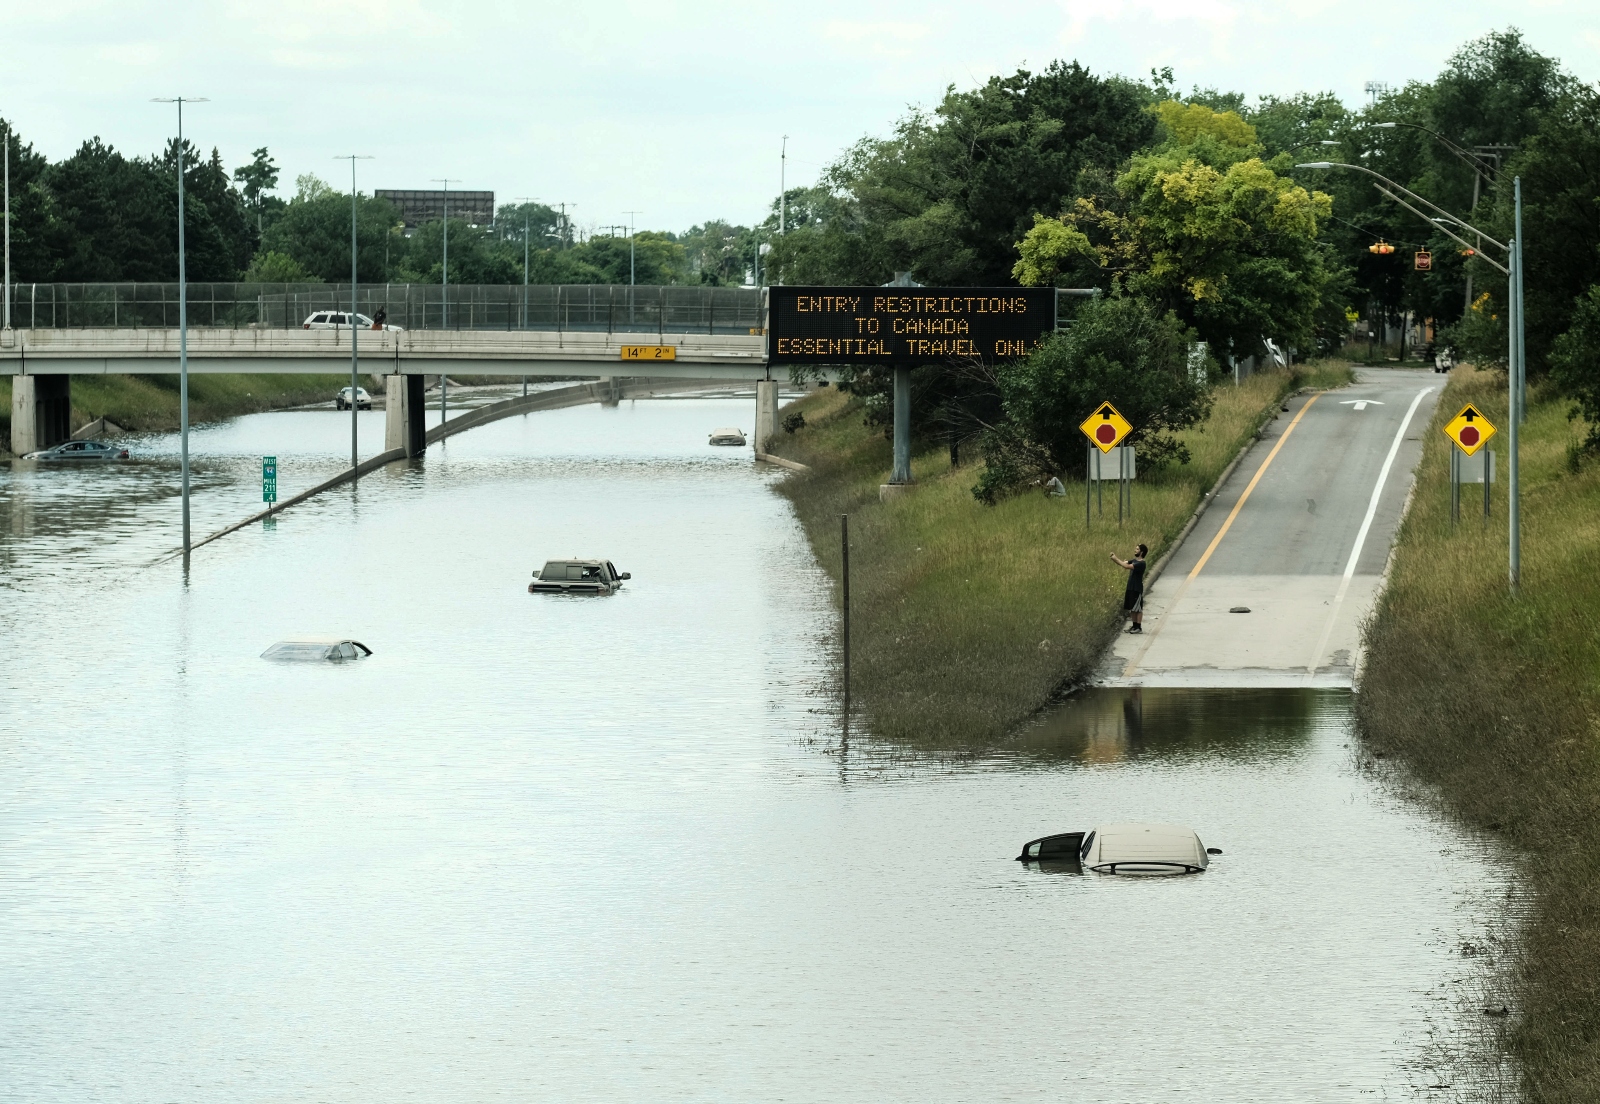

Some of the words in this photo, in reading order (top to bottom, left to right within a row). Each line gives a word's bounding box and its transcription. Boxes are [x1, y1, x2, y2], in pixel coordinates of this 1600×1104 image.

[797, 296, 860, 312] ENTRY
[874, 297, 1027, 313] RESTRICTIONS
[855, 317, 879, 334] TO
[893, 318, 969, 334] CANADA
[778, 338, 892, 355] ESSENTIAL
[906, 339, 981, 356] TRAVEL
